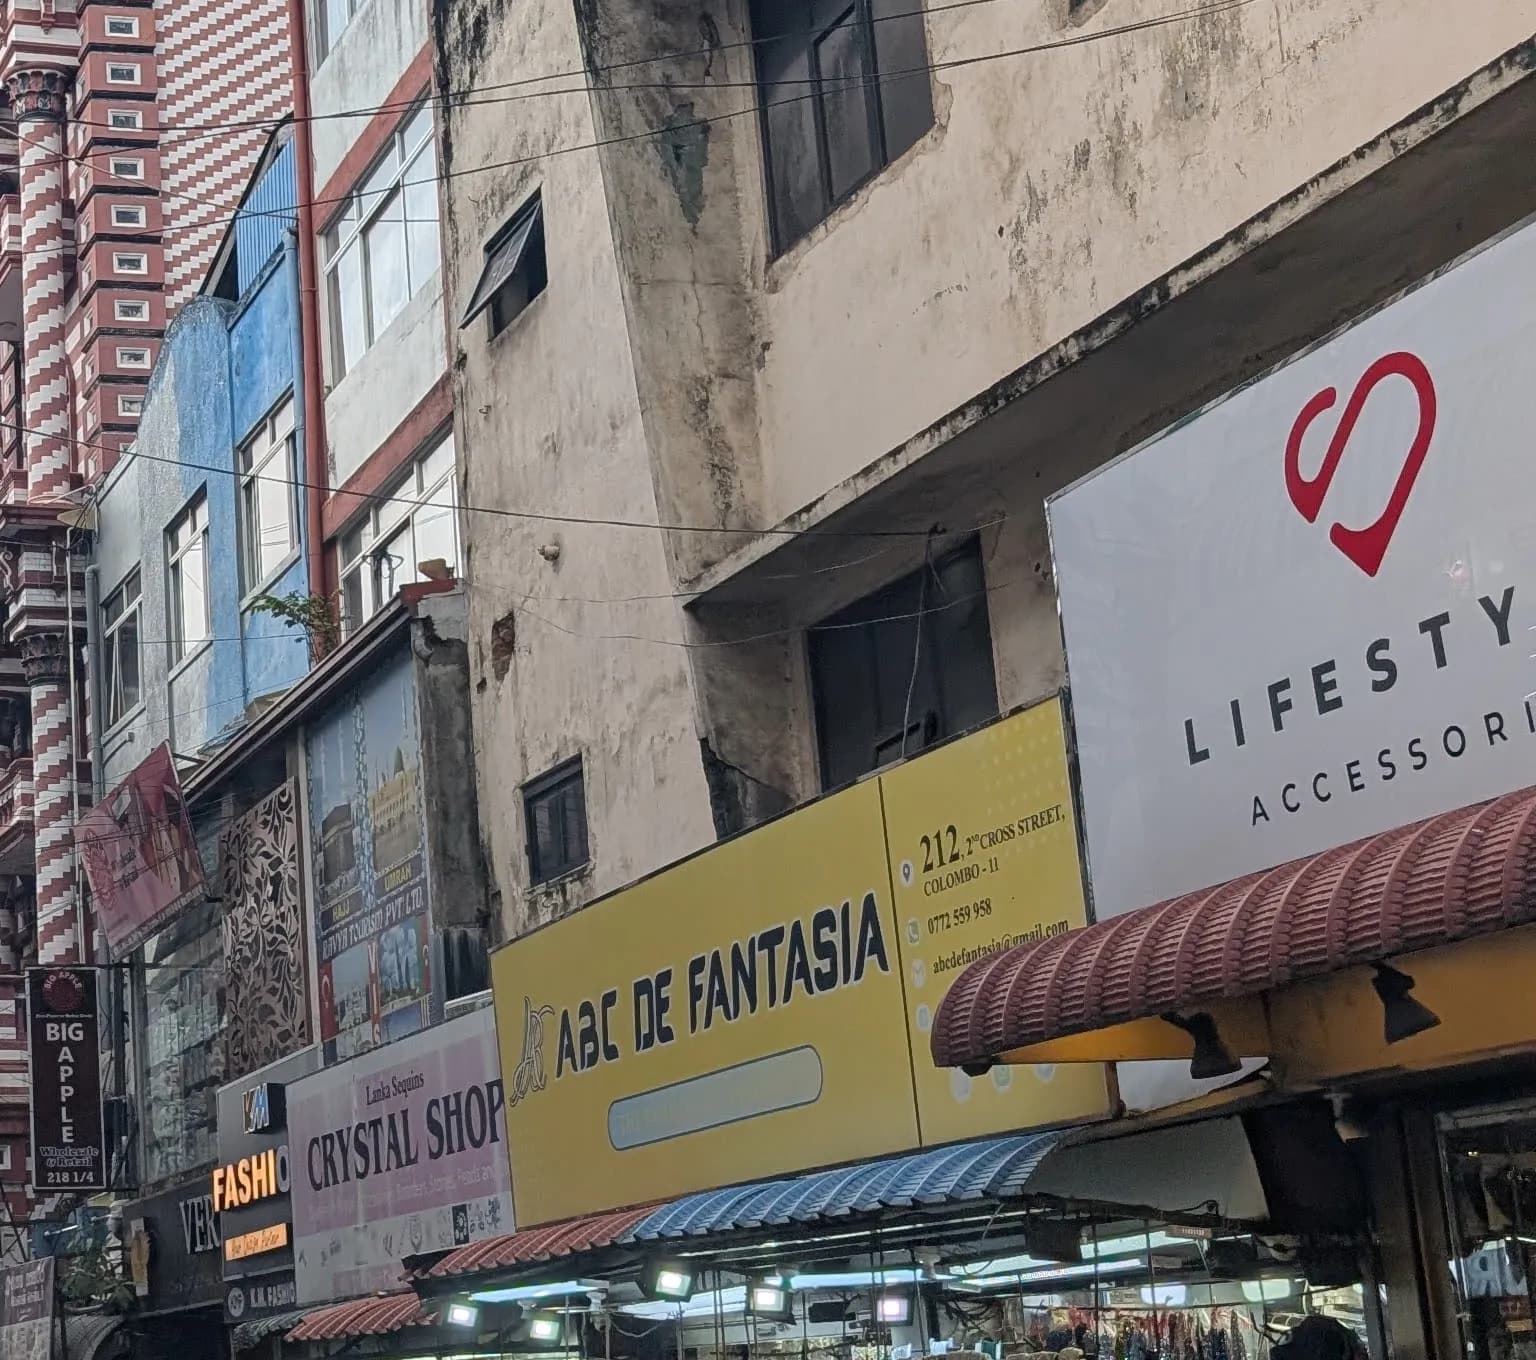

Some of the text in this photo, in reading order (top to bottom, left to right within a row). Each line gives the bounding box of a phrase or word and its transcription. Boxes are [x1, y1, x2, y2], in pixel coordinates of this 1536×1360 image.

[1183, 586, 1517, 767] LIFESTY
[980, 823, 1016, 850] CROSS
[1018, 804, 1066, 836] STREET,
[923, 862, 980, 897] COLOMBO
[989, 856, 999, 874] 11
[927, 897, 992, 935] 0772 559 958
[555, 989, 620, 1079] ABC
[633, 967, 675, 1052] DE
[688, 891, 890, 1034] FANTASIA
[45, 1022, 84, 1042] BIG
[57, 1046, 75, 1143] APPLE
[366, 1069, 424, 1106] Lanka Sequins
[307, 1078, 504, 1192] CRYSTAL SHOP
[47, 1171, 95, 1184] 218 1/4
[57, 1155, 93, 1168] Retail
[214, 1144, 290, 1214] FASHIO
